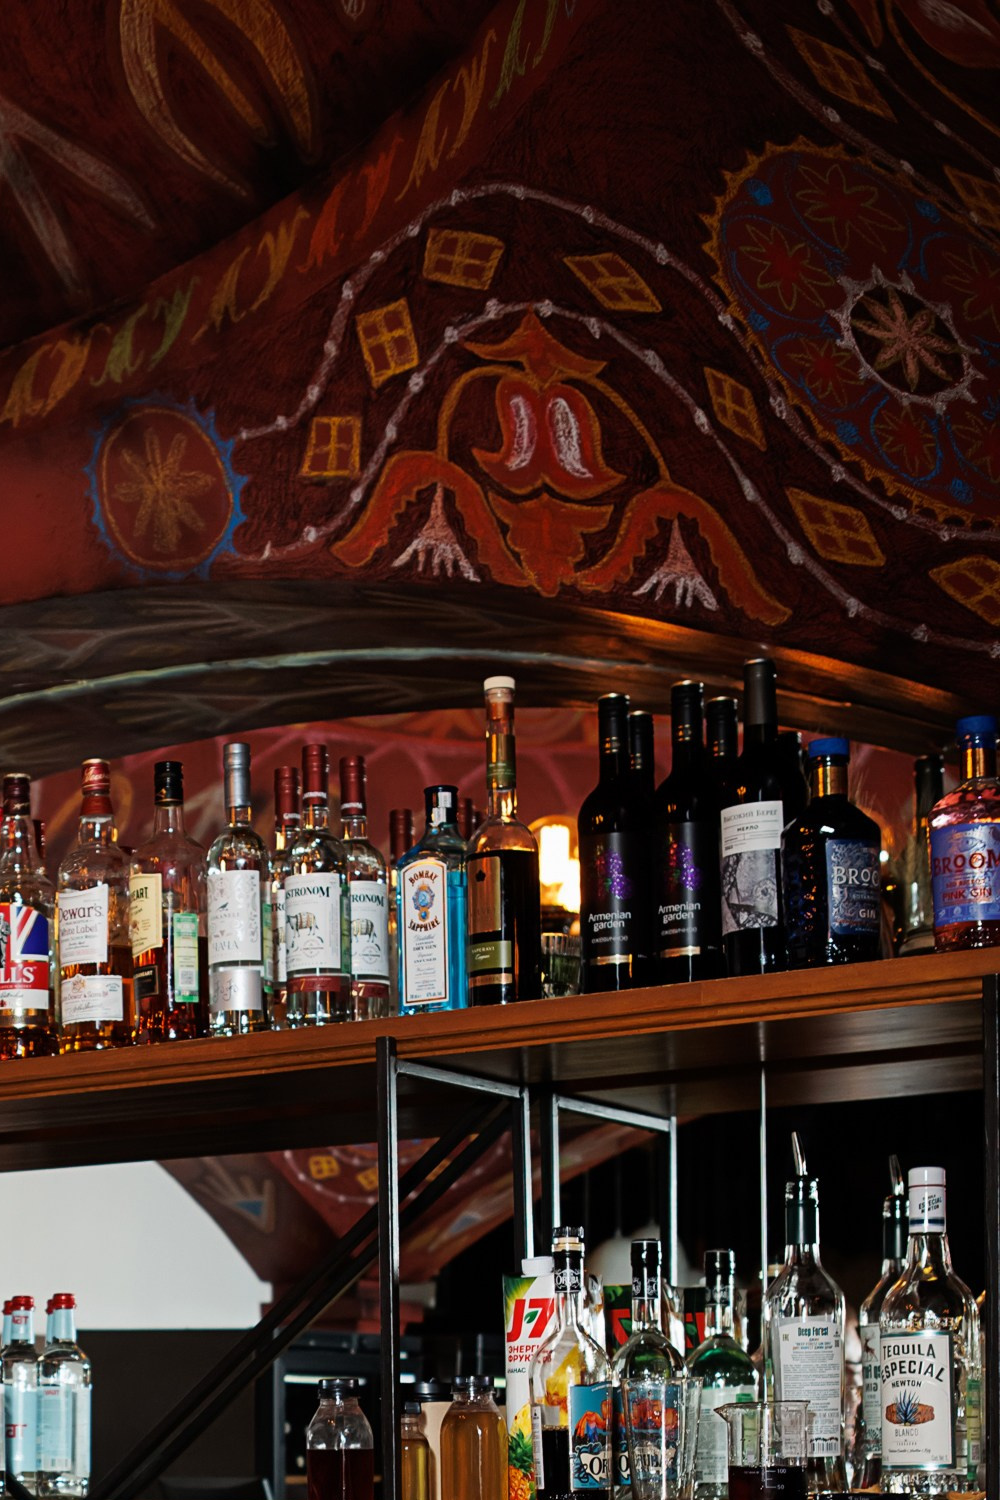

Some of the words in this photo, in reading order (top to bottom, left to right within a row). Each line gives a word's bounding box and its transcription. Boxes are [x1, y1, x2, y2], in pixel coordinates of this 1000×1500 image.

[737, 824, 759, 832] МЕРЛО
[409, 870, 438, 886] BOMBAY
[943, 890, 966, 900] PINK
[970, 887, 992, 898] GIN
[658, 901, 701, 914] Armenian
[859, 908, 876, 919] GIN
[588, 911, 632, 922] Armenian
[662, 911, 694, 924] garden
[408, 916, 440, 932] SAPPHIRE
[593, 920, 625, 932] garden
[357, 983, 365, 996] 7
[919, 1197, 942, 1209] ESECIAL
[798, 1327, 811, 1338] Deep
[812, 1326, 829, 1337] Forest
[508, 1344, 540, 1354] ЭНЕРГ
[883, 1343, 936, 1361] TEQUILA
[880, 1360, 946, 1384] ESPECIAL
[891, 1379, 922, 1388] NEWTON
[895, 1428, 919, 1437] BLANCO
